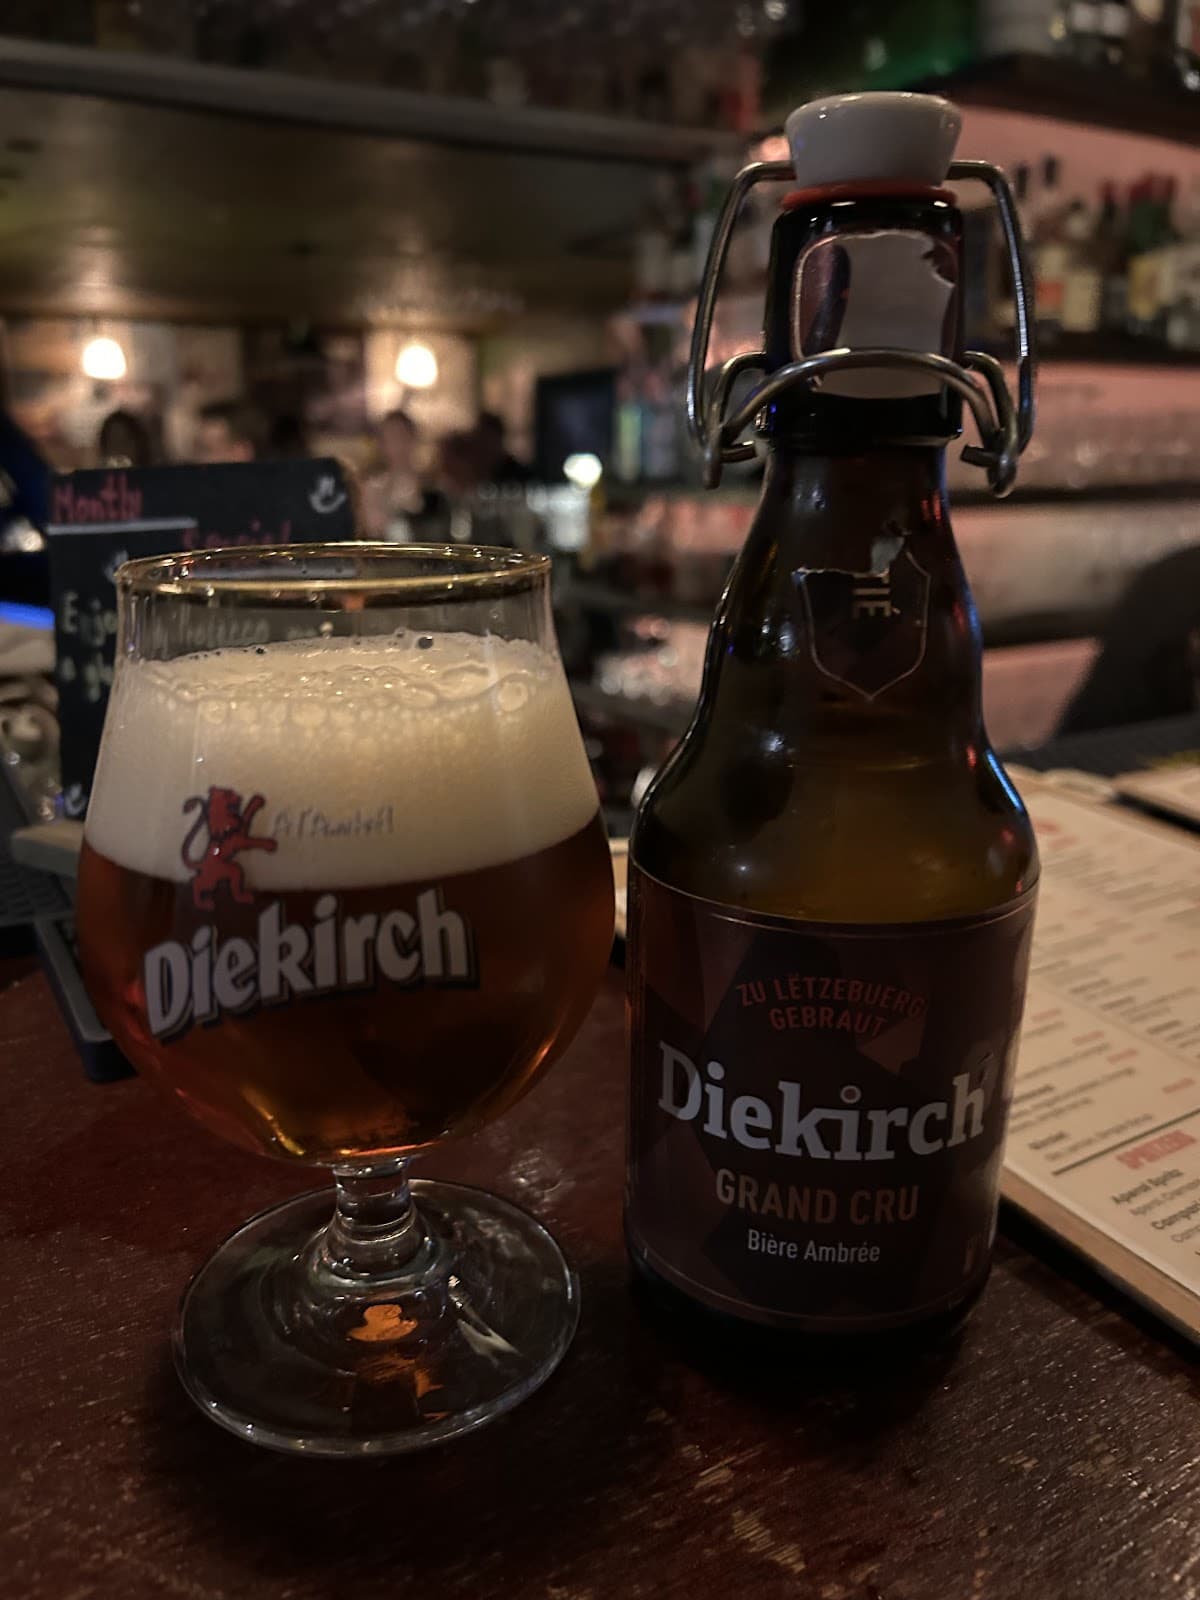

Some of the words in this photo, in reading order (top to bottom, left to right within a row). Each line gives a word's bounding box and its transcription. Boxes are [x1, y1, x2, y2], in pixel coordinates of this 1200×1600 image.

[144, 886, 479, 1040] Diekirch
[736, 978, 768, 1008] ZU
[768, 1004, 888, 1039] GEBRAUT
[657, 1039, 986, 1161] Diekirch
[715, 1168, 838, 1225] GRAND
[849, 1185, 920, 1226] CRU
[747, 1227, 799, 1260] Bière
[803, 1240, 881, 1264] Ambrée
